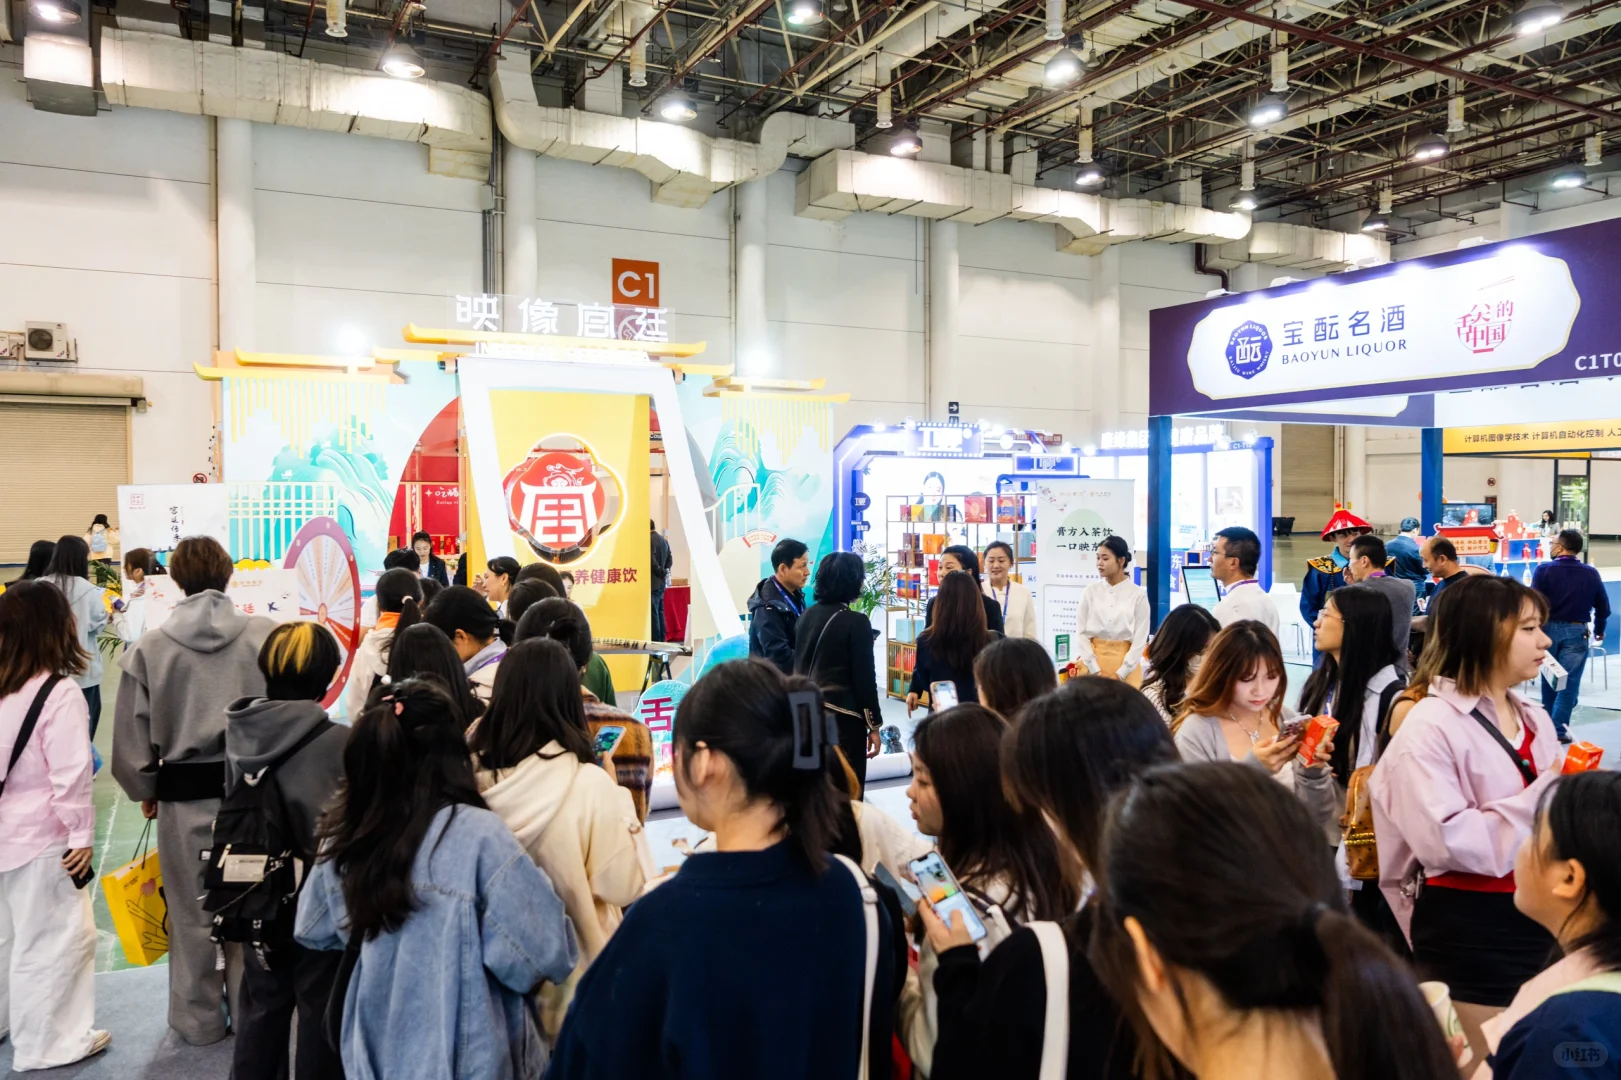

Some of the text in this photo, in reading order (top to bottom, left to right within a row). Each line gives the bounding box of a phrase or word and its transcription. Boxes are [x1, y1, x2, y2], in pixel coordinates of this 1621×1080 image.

[617, 270, 655, 299] C1
[1282, 304, 1406, 347] 宝酝名酒
[1281, 339, 1408, 365] BAOYUN LIQUOR
[1056, 525, 1114, 538] 膏方入茶饮
[560, 567, 638, 585] 养健康饮
